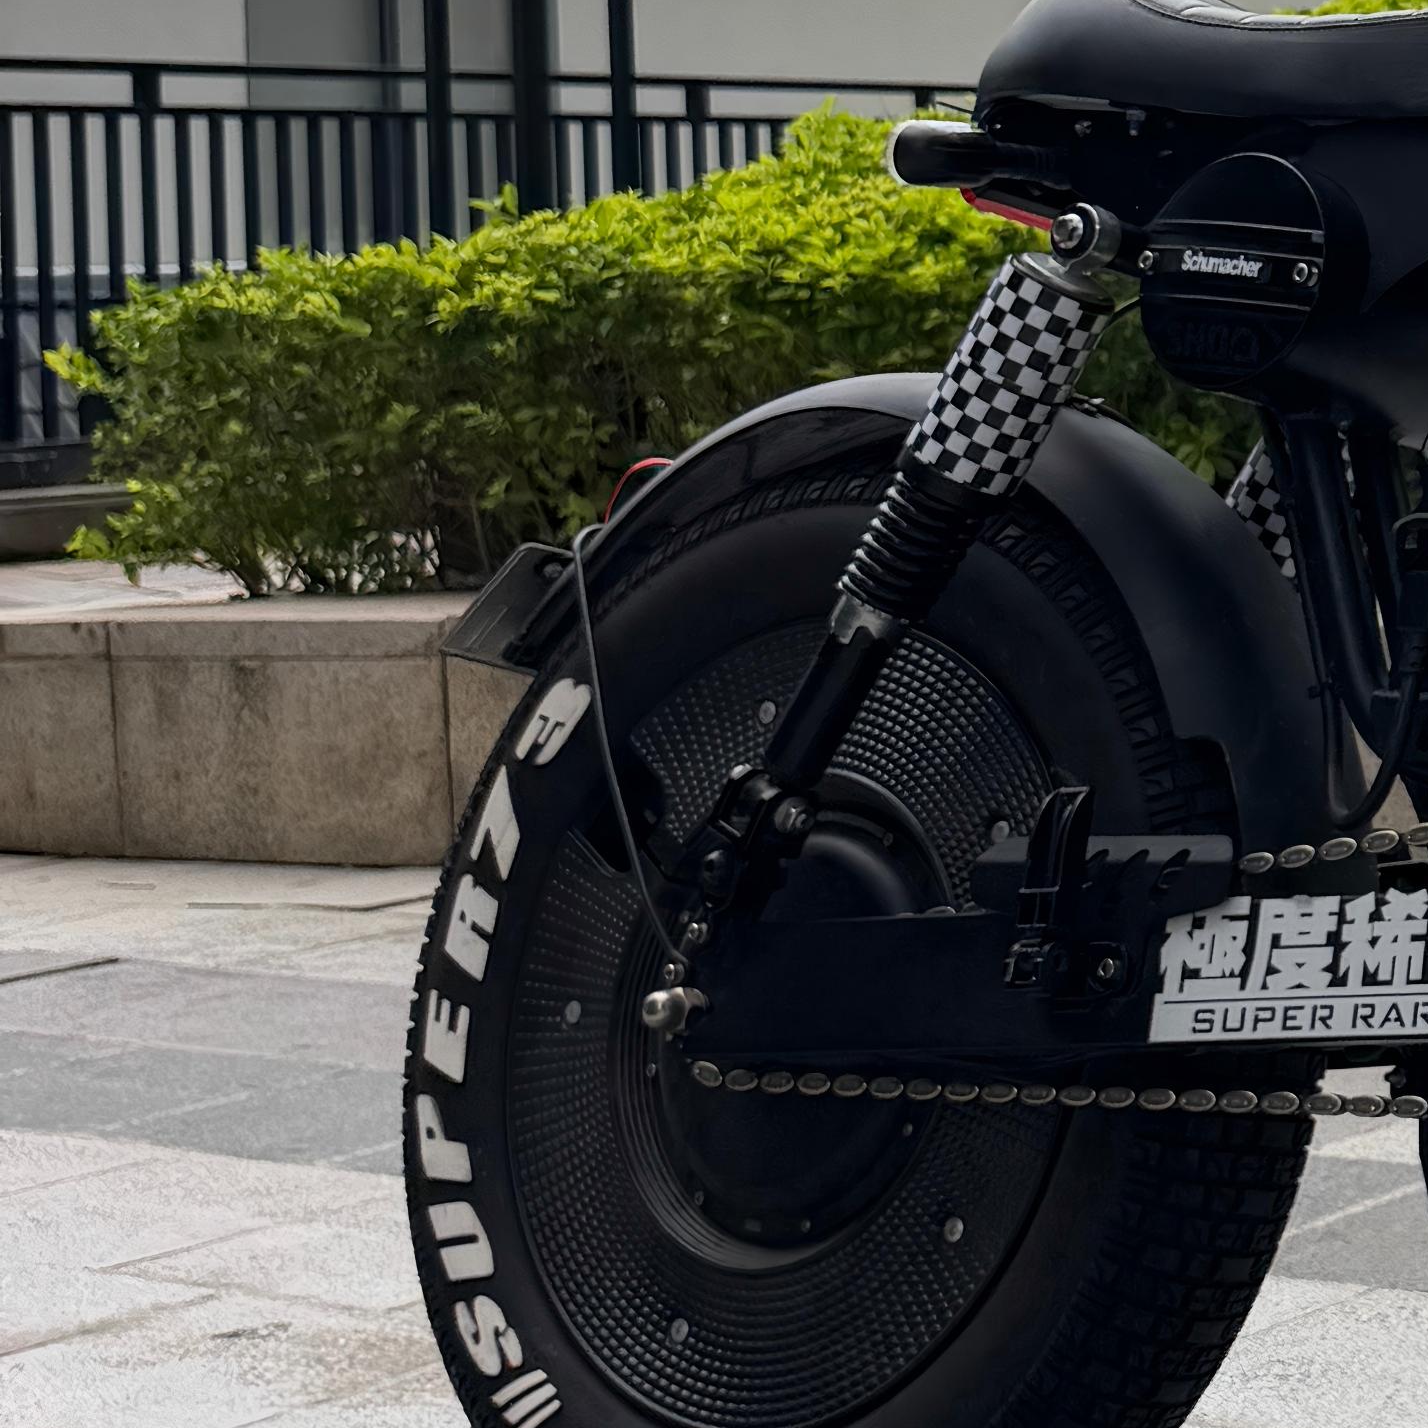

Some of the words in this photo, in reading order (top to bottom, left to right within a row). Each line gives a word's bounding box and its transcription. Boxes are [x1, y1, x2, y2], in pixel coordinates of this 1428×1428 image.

[1181, 249, 1263, 278] Schumacher
[415, 676, 592, 1374] SUPER73
[1191, 1002, 1335, 1035] SUPER
